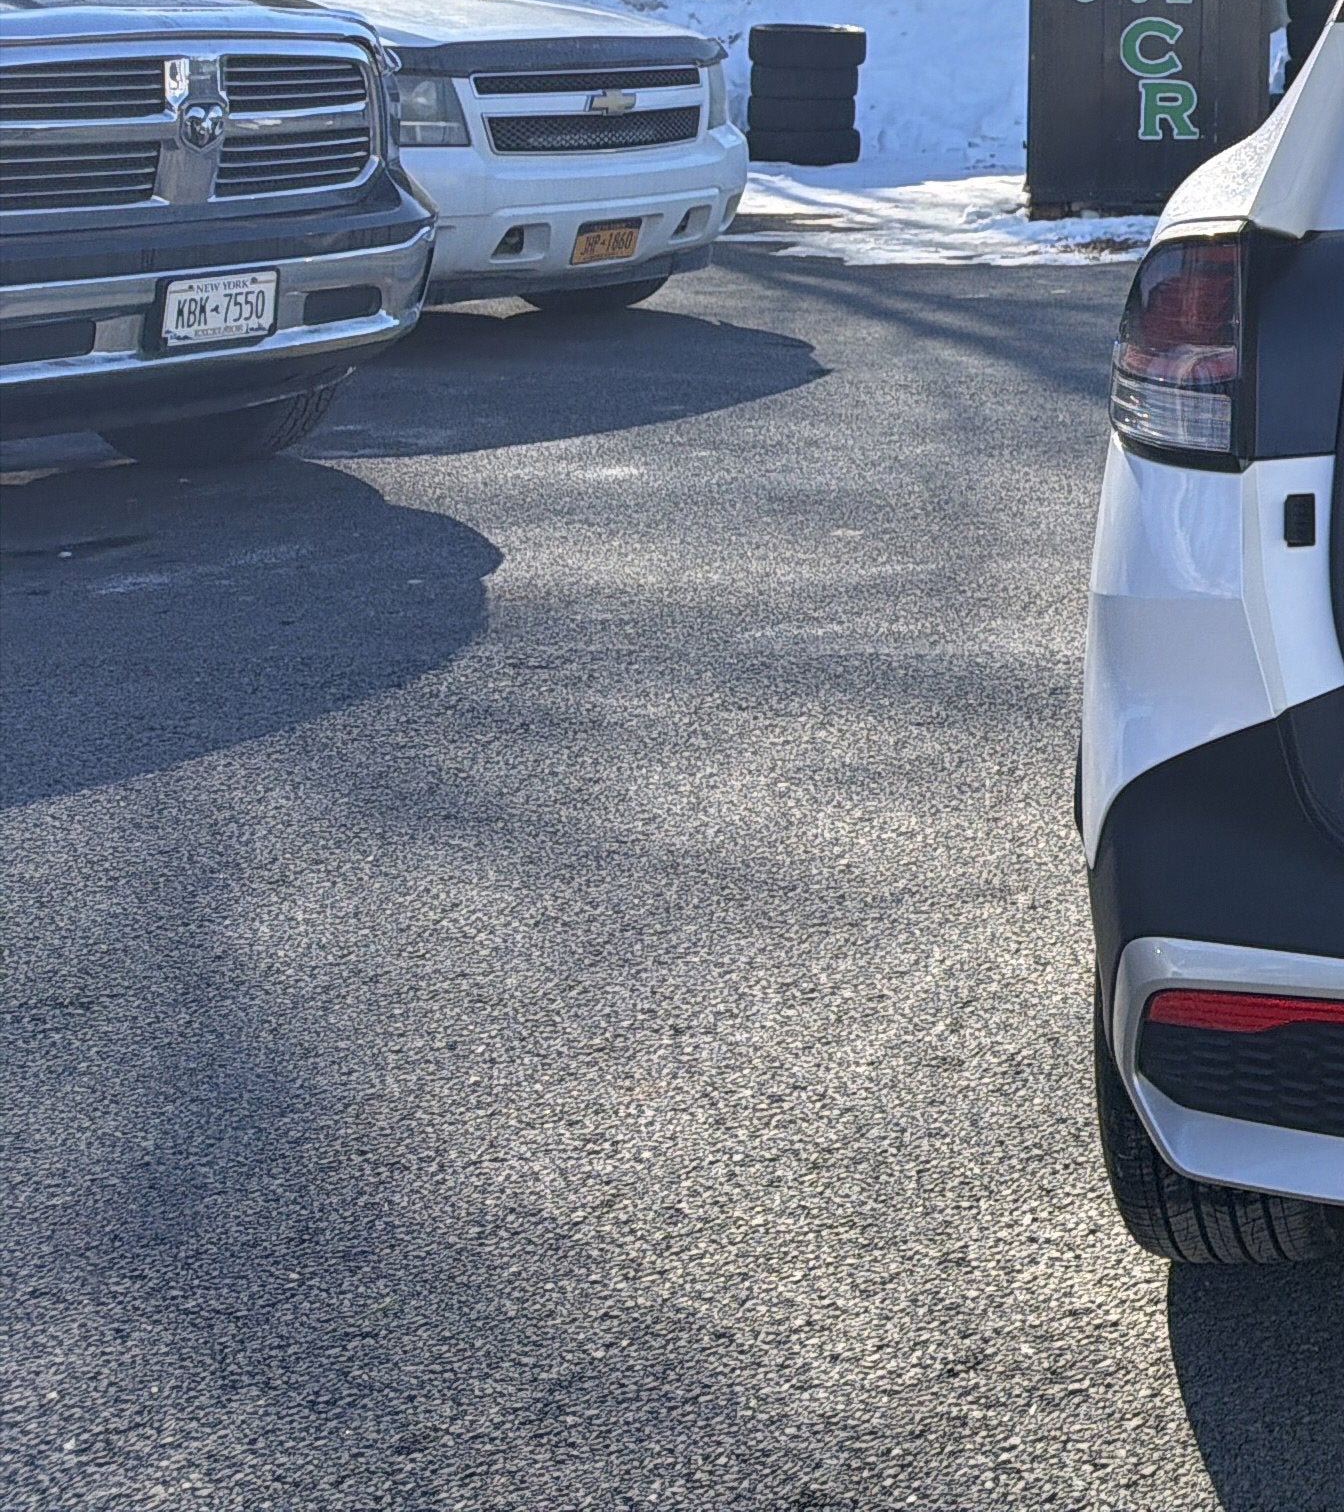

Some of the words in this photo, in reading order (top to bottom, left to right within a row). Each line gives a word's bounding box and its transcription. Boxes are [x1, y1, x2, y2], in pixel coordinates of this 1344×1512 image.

[1120, 17, 1183, 77] C
[1139, 79, 1199, 140] R
[196, 282, 220, 294] NEW
[221, 279, 249, 291] YORK
